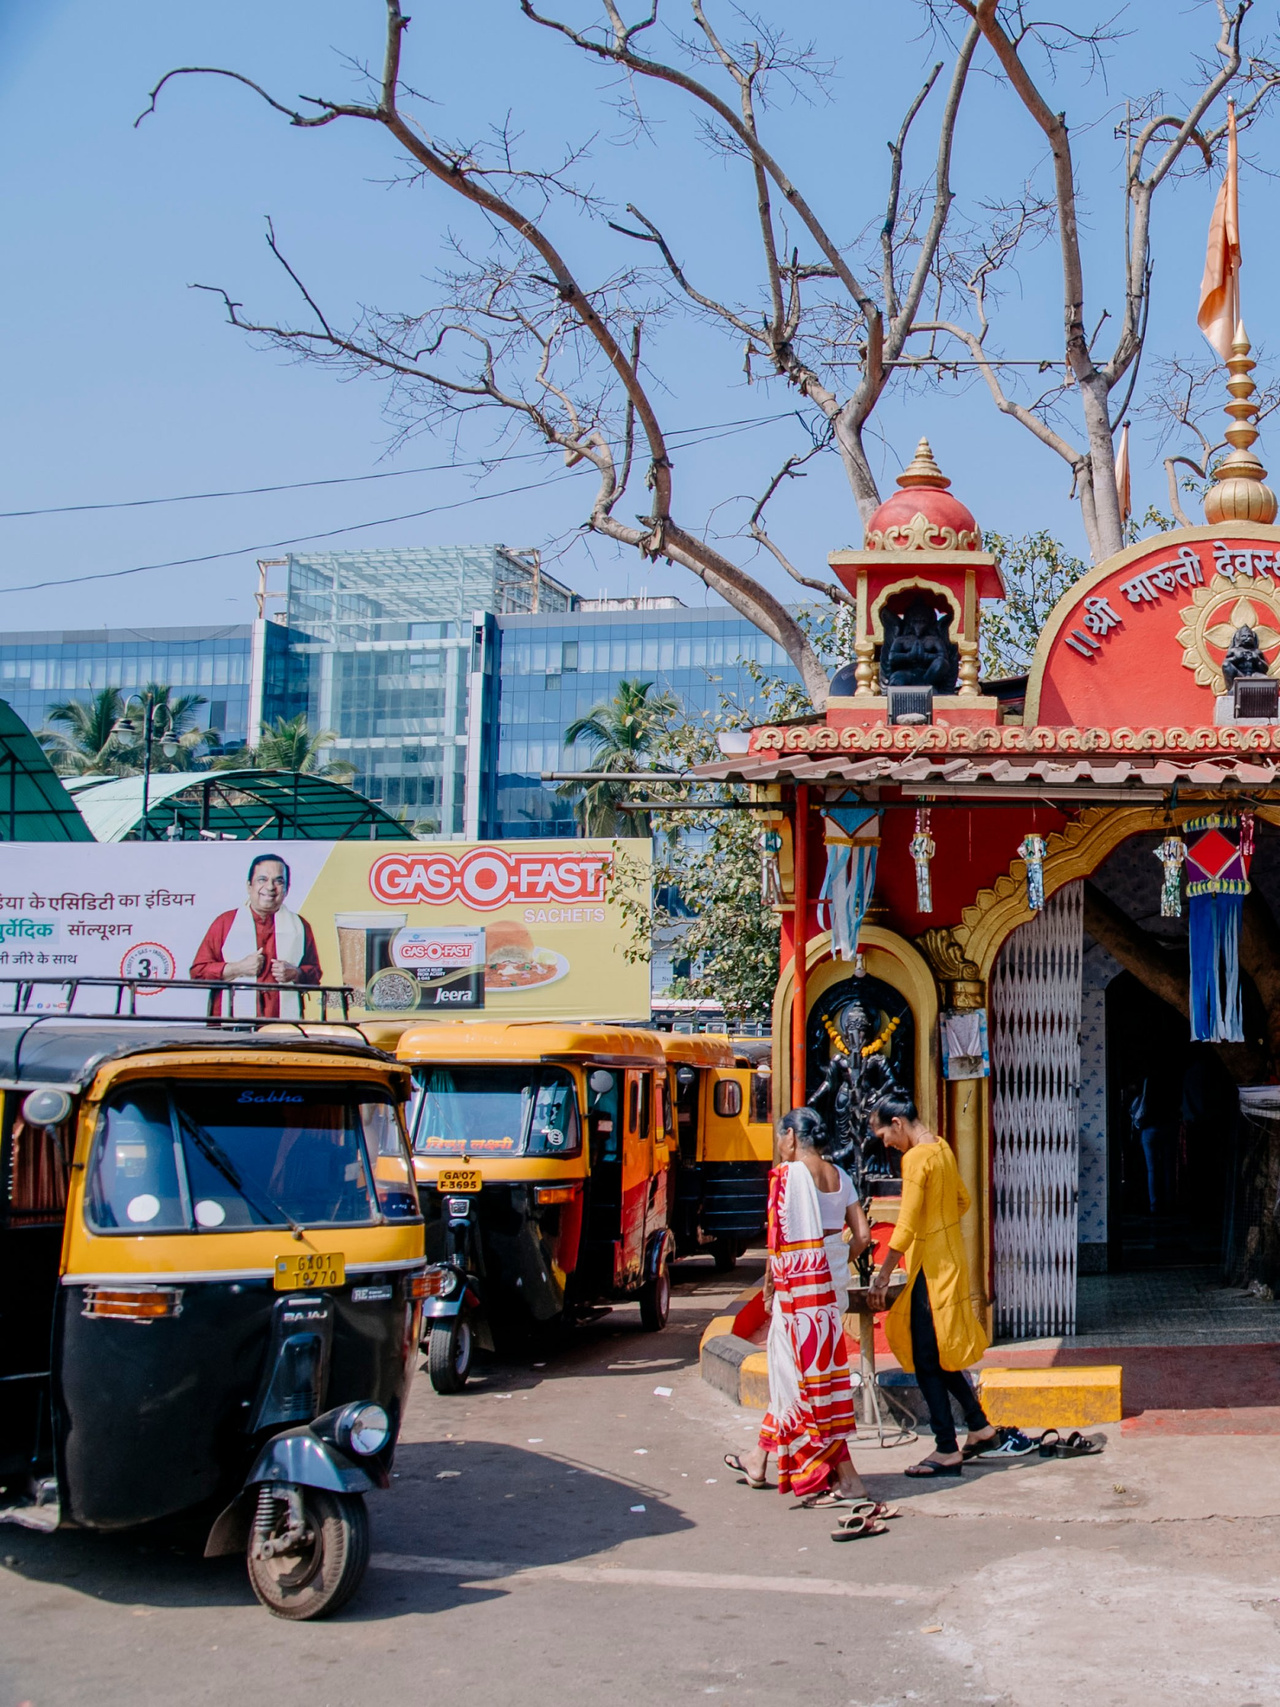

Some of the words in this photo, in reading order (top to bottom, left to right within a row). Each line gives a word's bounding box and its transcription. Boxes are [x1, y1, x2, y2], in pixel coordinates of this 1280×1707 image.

[1083, 596, 1122, 635] श्री
[28, 892, 46, 910] के
[49, 892, 115, 911] एसिडिटी
[118, 894, 140, 907] का
[145, 889, 195, 909] इंडियन
[524, 908, 605, 924] SACHETS
[67, 920, 133, 940] सॉल्यूशन
[12, 951, 34, 964] जीरे
[37, 951, 50, 964] के
[52, 953, 78, 964] साथ
[138, 958, 151, 979] 3
[434, 988, 472, 1004] Jeera
[283, 1310, 328, 1321] BAJAJ
